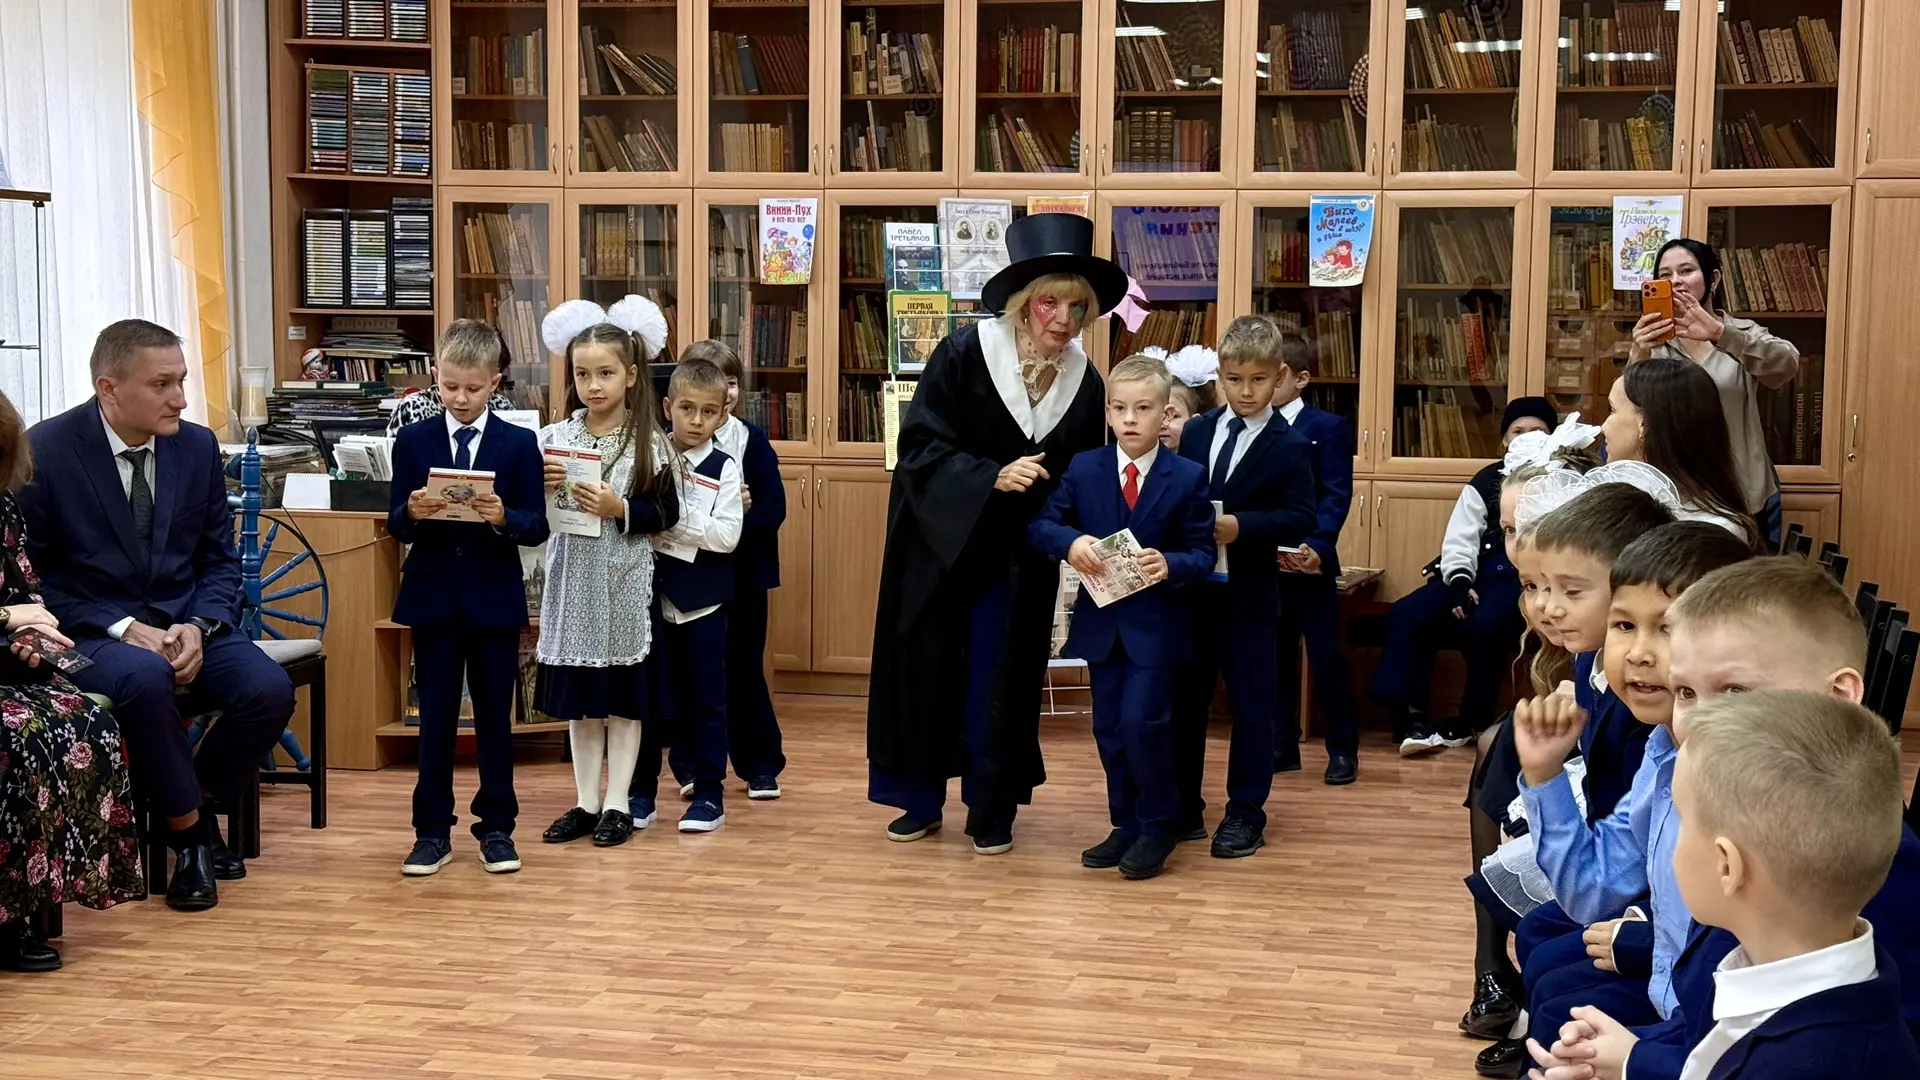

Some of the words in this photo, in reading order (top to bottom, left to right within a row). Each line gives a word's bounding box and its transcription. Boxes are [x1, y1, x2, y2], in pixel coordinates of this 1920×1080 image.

[766, 204, 811, 216] Винни-Пух
[1323, 206, 1355, 217] Витя
[1316, 216, 1358, 231] Малеев
[1620, 209, 1662, 227] Трэверс
[907, 302, 933, 310] ПЕРВАЯ
[1813, 391, 1822, 434] ПЕЙЗАЖ
